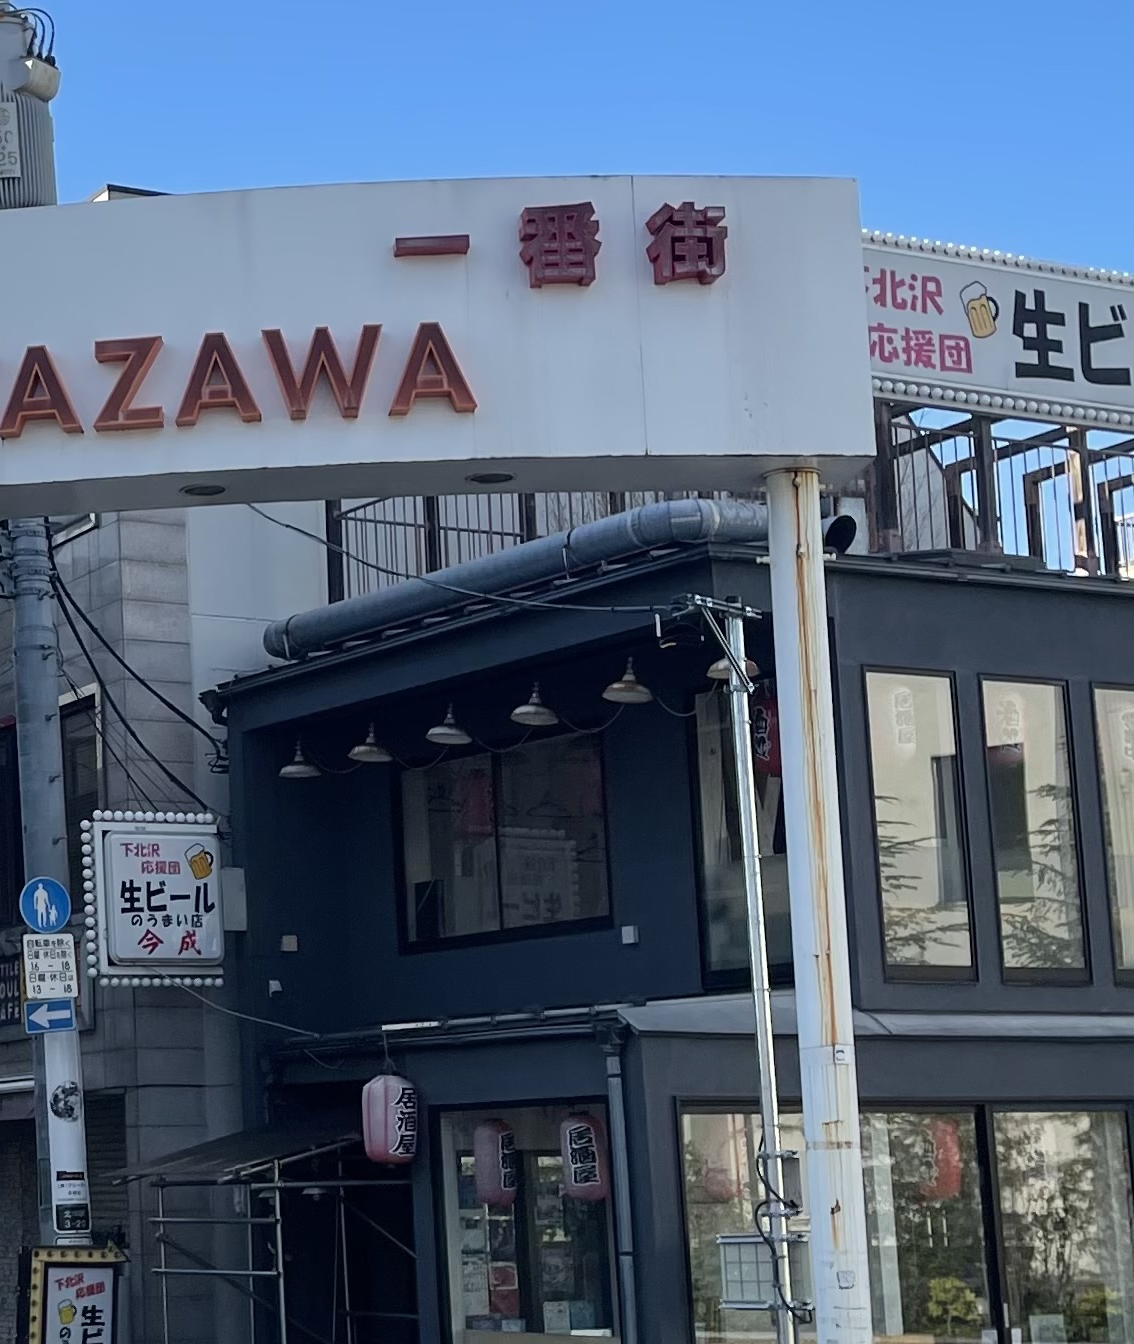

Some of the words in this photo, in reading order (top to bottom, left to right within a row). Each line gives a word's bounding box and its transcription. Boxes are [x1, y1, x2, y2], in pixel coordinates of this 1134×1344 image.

[394, 201, 728, 289] 一番街
[868, 323, 973, 374] 応援団
[119, 842, 161, 858] 下北沢
[141, 860, 181, 875] 応援団
[119, 878, 216, 915] 生ビール
[130, 913, 204, 928] のうまい店
[389, 1086, 416, 1157] 居酒屋
[568, 1124, 599, 1185] 居酒屋
